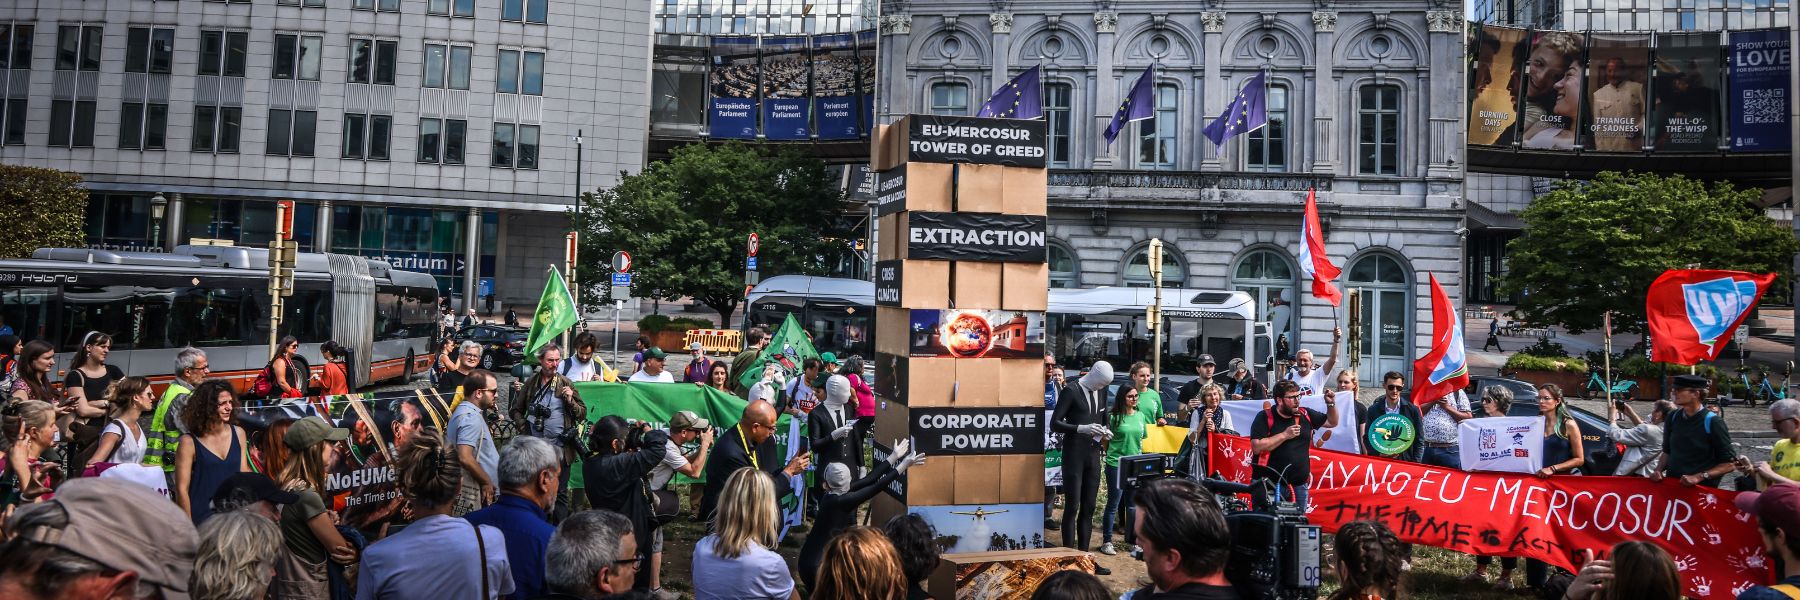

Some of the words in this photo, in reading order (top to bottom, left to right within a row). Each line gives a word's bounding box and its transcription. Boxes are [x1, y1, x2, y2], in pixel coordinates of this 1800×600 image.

[1736, 42, 1763, 50] SHOW
[1765, 40, 1790, 49] YOUR
[1736, 49, 1790, 67] LOVE
[715, 102, 751, 110] Europäisches
[774, 103, 799, 111] European
[825, 110, 848, 118] européen
[1479, 110, 1508, 119] BURNING
[1540, 114, 1562, 122] CLOSE
[1484, 118, 1501, 126] DAYS
[1603, 124, 1639, 132] SADNESS
[922, 124, 1030, 140] EU-MERCOSUR
[911, 141, 967, 154] TOWER
[971, 144, 991, 155] OF
[995, 145, 1045, 157] GREED
[910, 228, 1045, 246] EXTRACTION
[801, 400, 813, 408] STOP
[919, 413, 1036, 429] CORPORATE
[941, 434, 1014, 449] POWER
[1482, 435, 1497, 443] SIN
[326, 466, 396, 491] NoEUMe
[345, 496, 362, 507] The
[364, 493, 385, 504] Time
[387, 491, 396, 500] to
[1325, 500, 1391, 525] THE
[1415, 469, 1695, 545] EU-MERCOSUR
